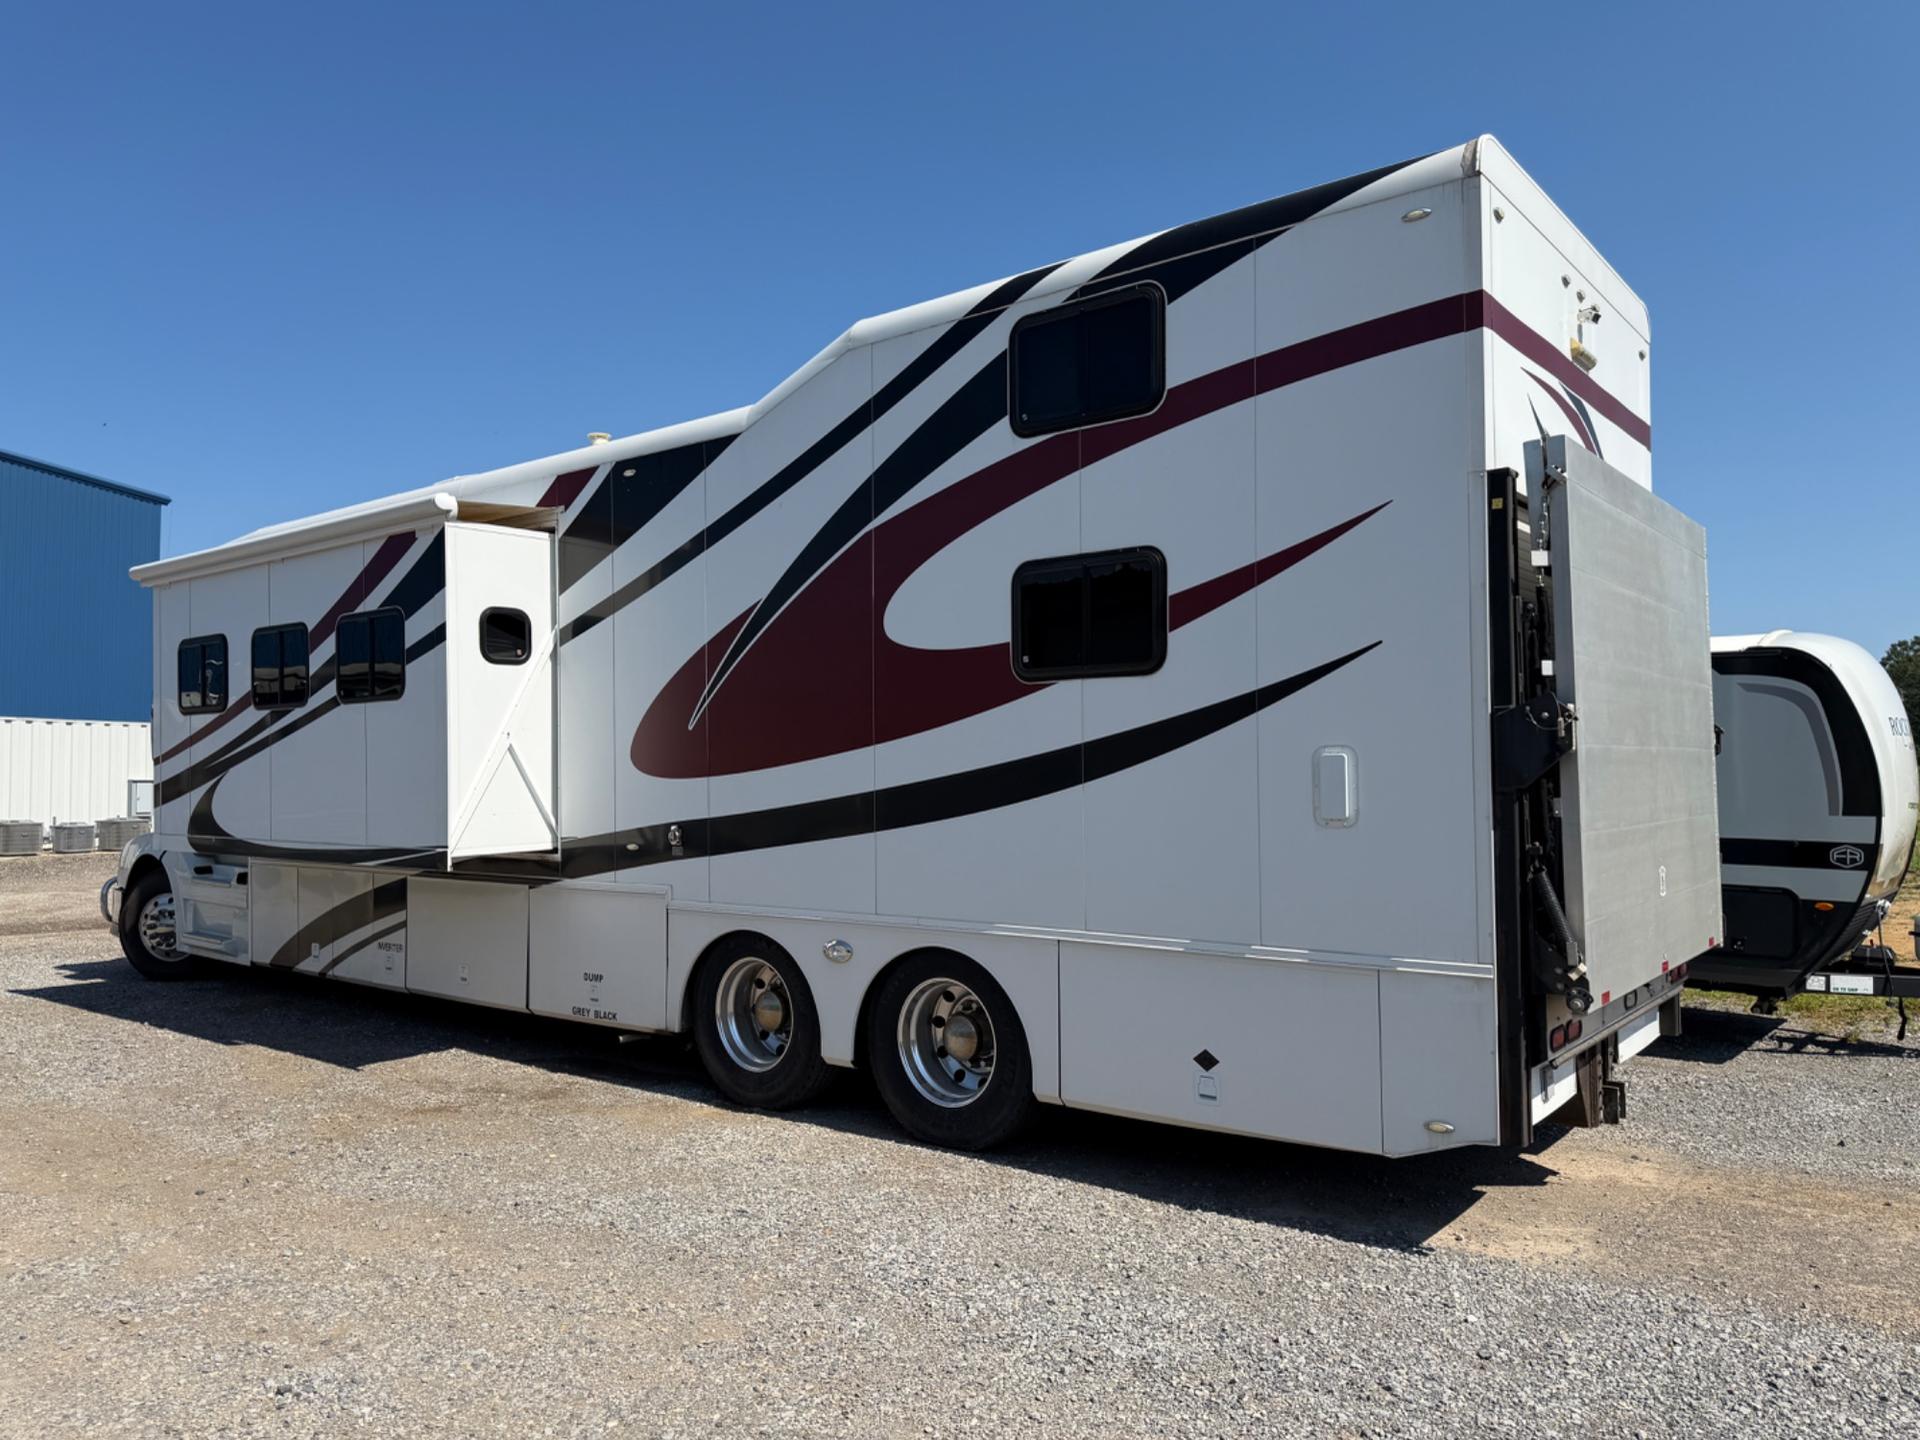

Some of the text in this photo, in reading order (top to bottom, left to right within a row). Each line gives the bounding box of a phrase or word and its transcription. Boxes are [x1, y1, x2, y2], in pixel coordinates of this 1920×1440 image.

[583, 971, 604, 983] DUMP
[571, 1006, 618, 1022] GREY BLACK
